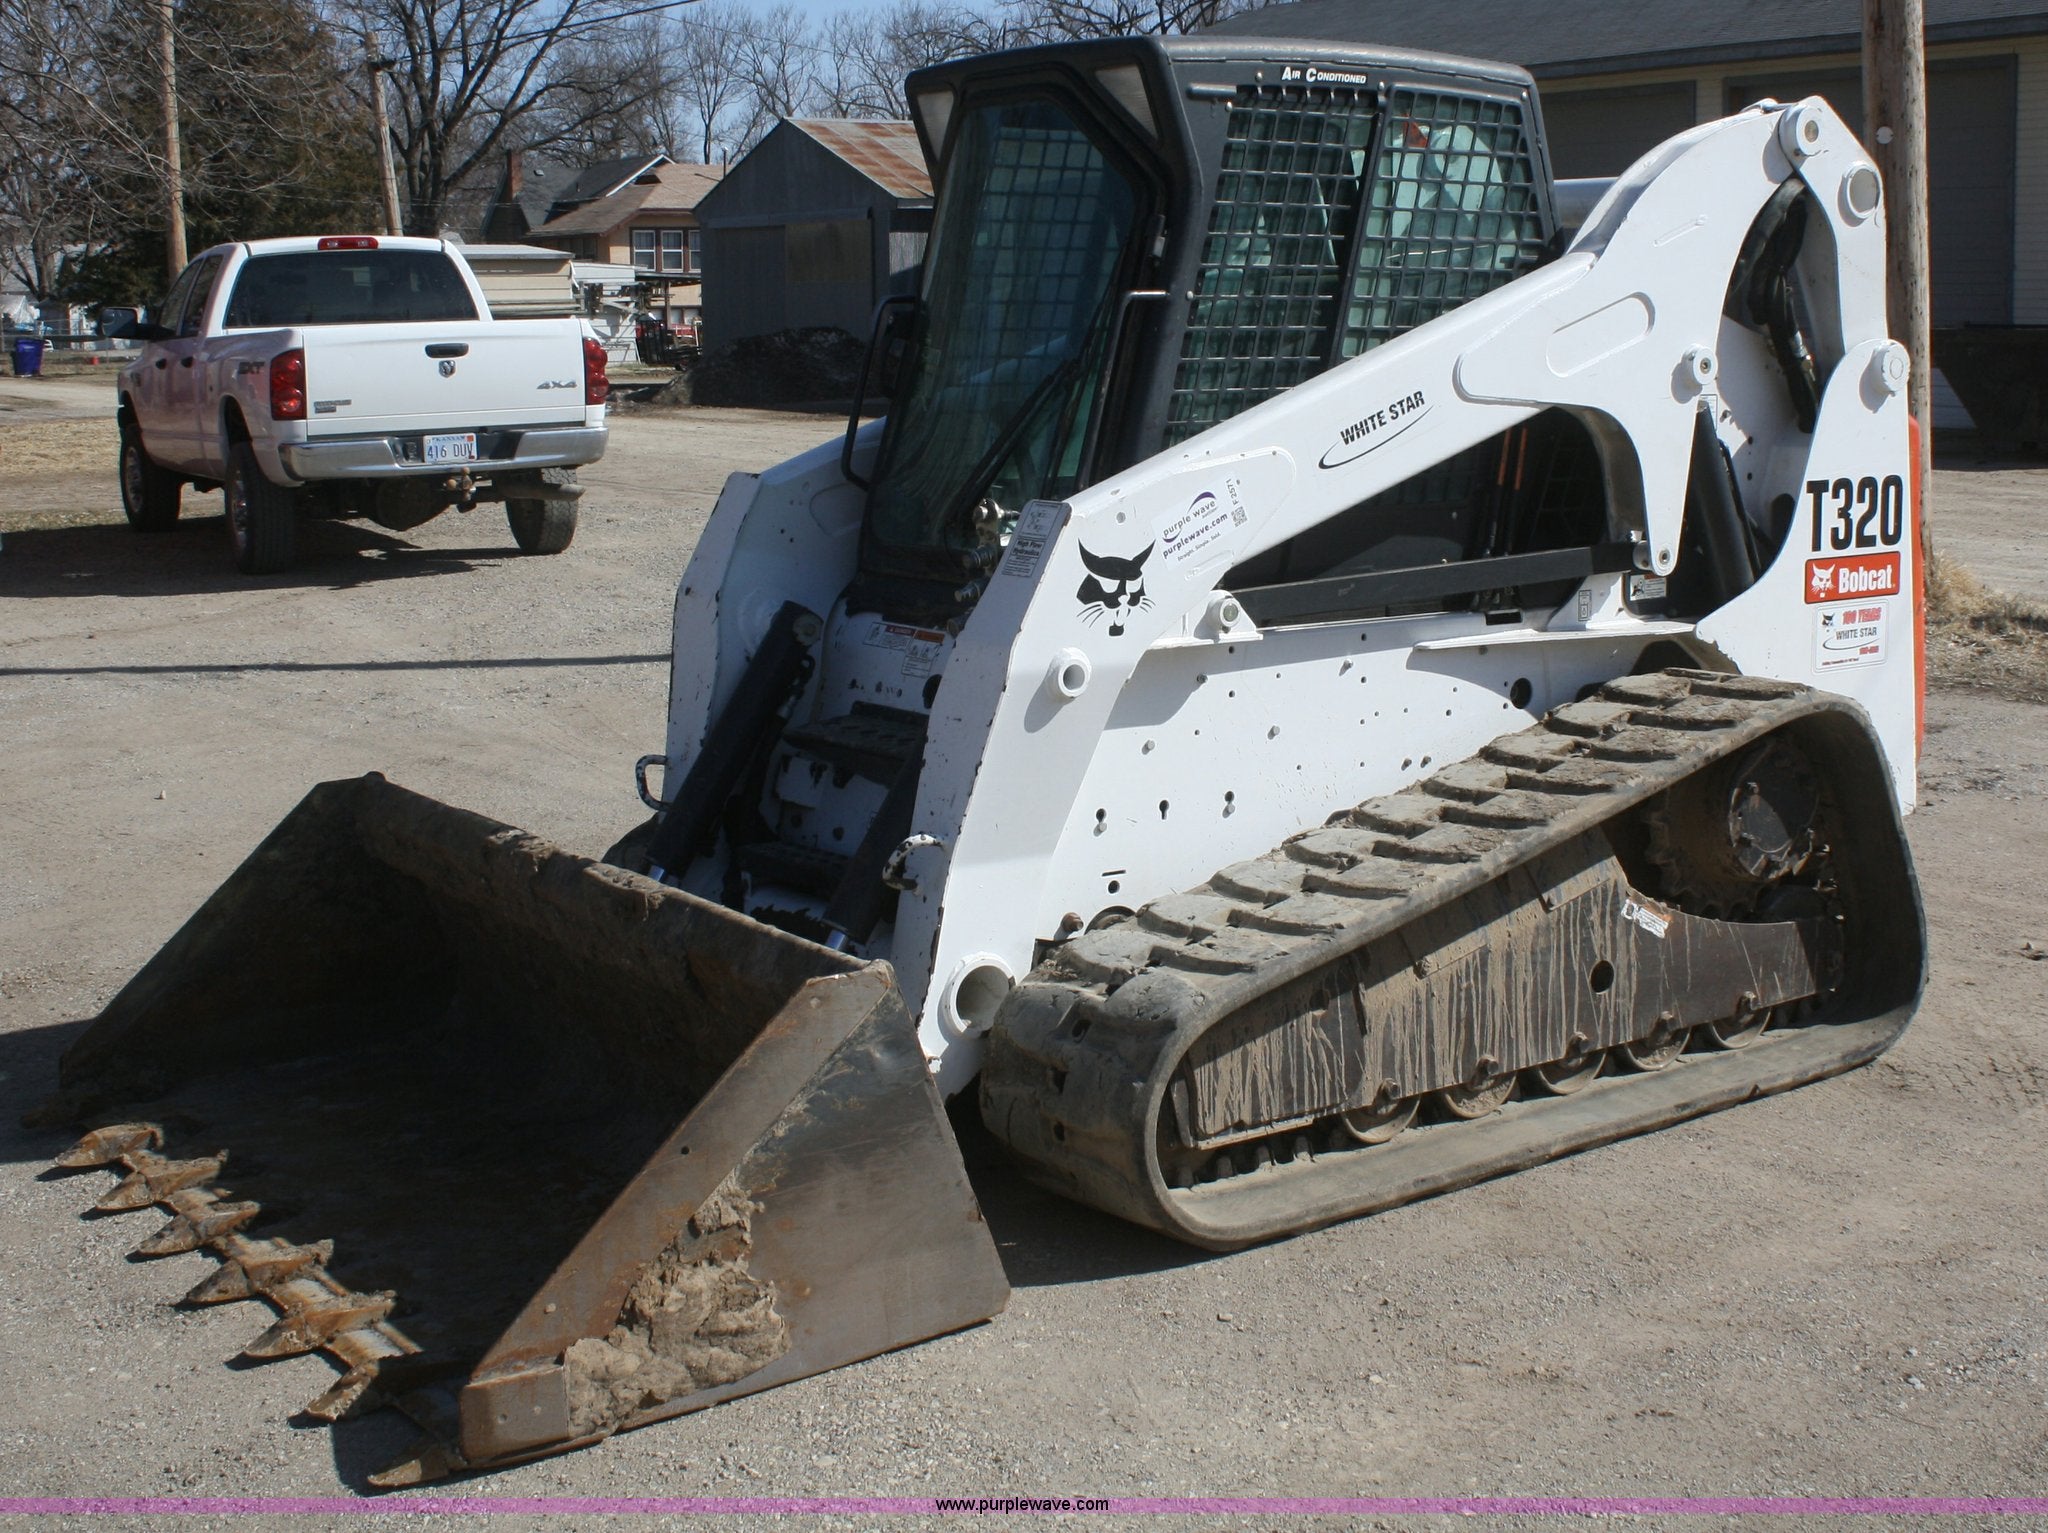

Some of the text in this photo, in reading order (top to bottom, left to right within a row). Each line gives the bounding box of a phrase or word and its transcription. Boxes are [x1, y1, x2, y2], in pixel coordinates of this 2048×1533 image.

[1281, 66, 1366, 84] AIR CONDITIONED
[1340, 390, 1425, 446] WHITE STAR
[427, 444, 447, 459] 416
[1163, 500, 1216, 538] purple wave
[1806, 474, 1903, 552] T320
[1162, 513, 1228, 559] purplewave.com
[1838, 564, 1892, 594] Bobcat
[1836, 627, 1877, 640] WHITE STAR
